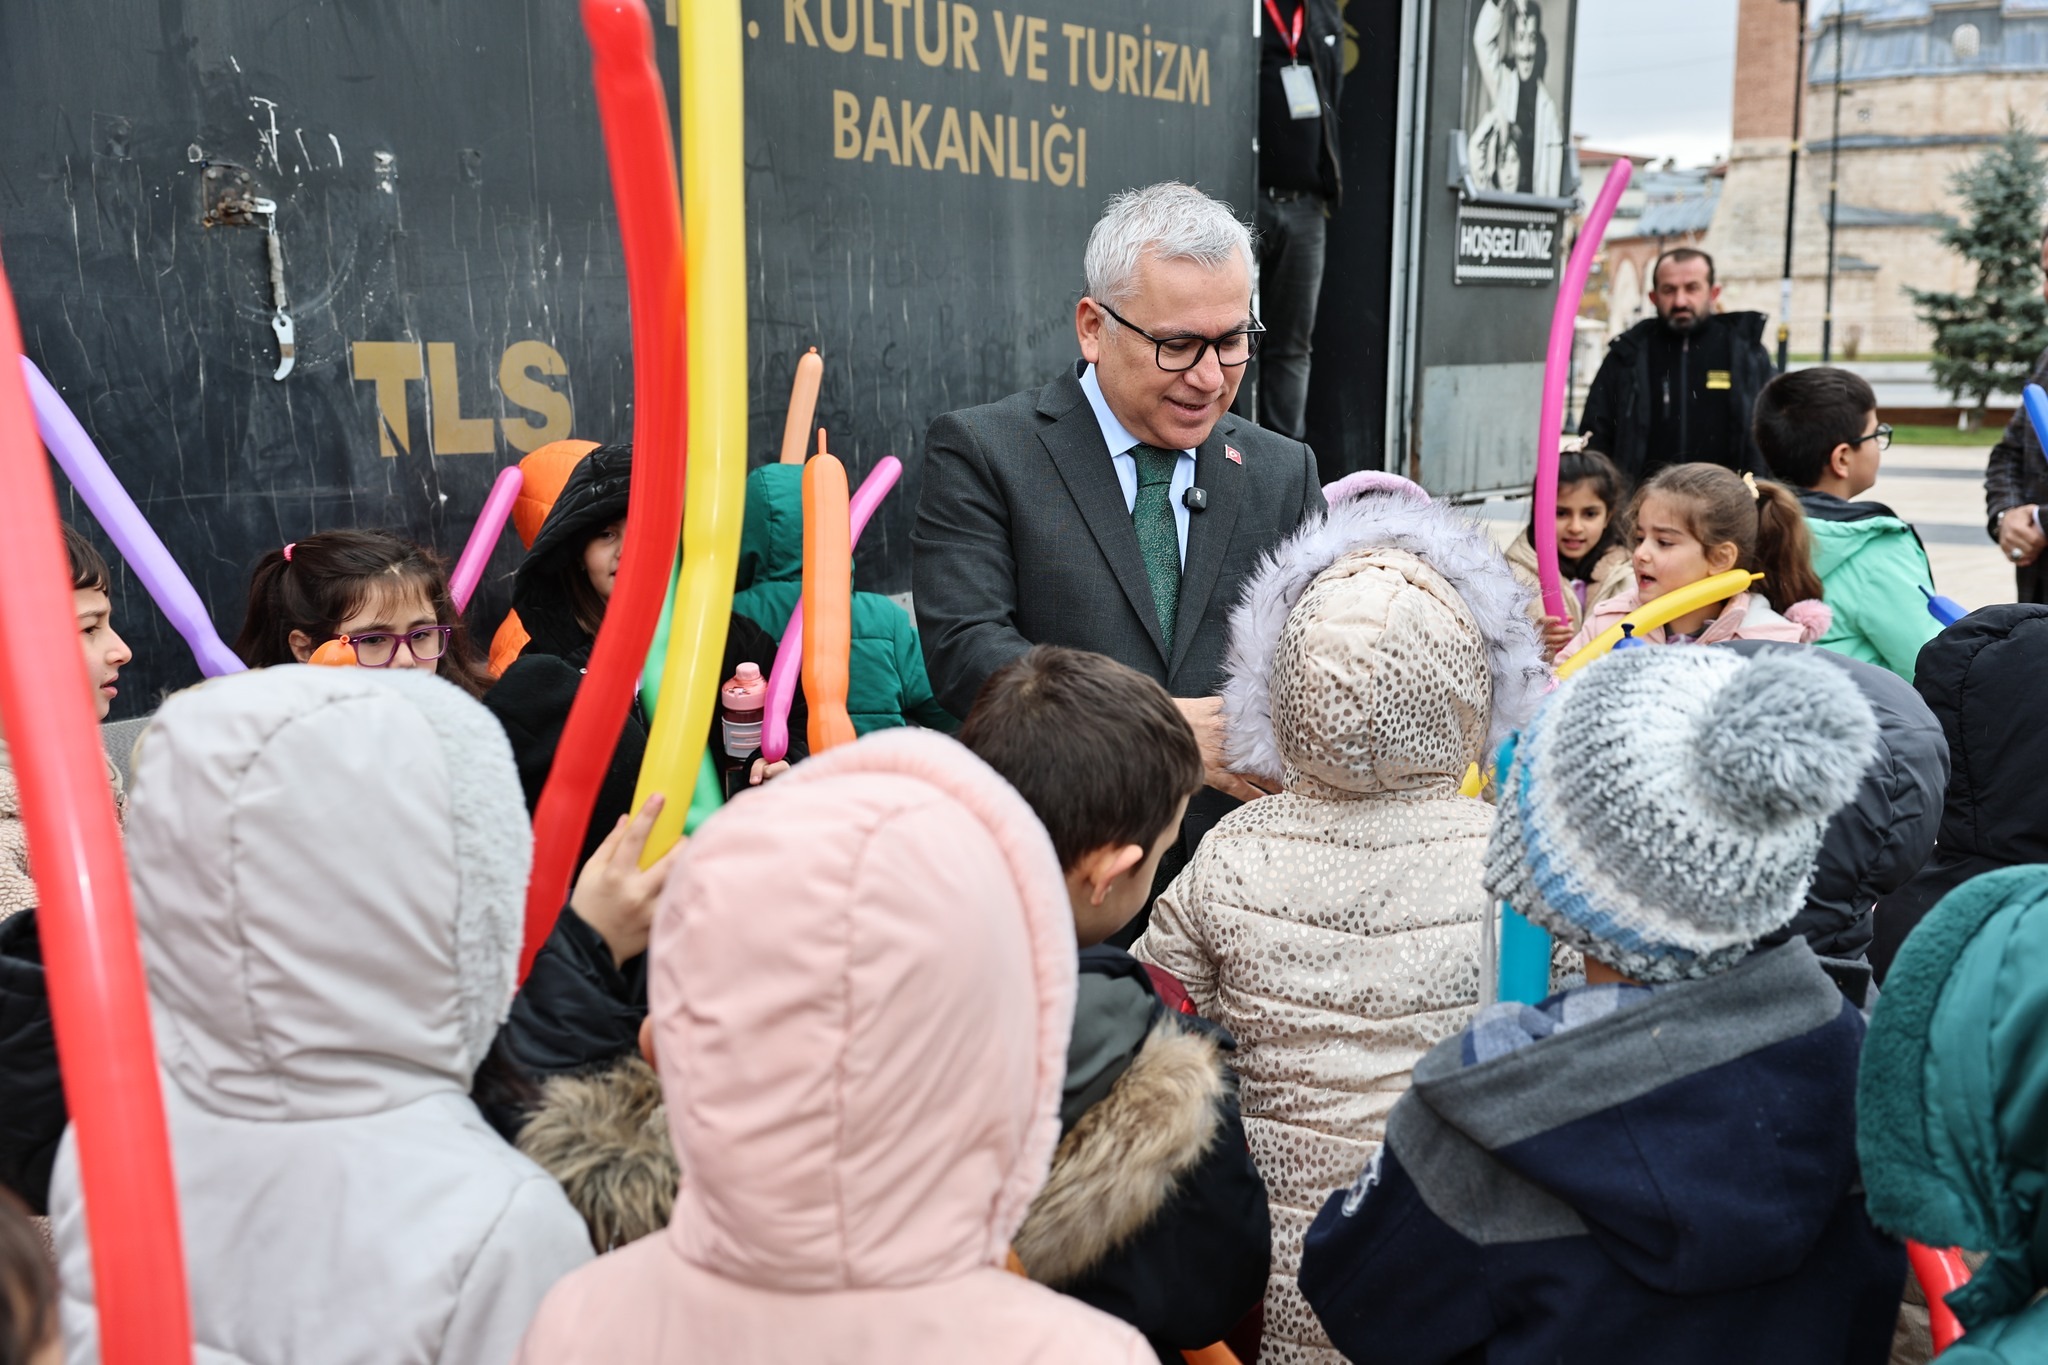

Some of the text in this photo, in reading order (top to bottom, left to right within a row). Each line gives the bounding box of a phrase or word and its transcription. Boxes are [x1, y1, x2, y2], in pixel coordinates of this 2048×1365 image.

[993, 10, 1048, 82] VE
[1062, 23, 1211, 107] TURİZM
[833, 89, 1087, 188] BAKANLIĞI
[1460, 222, 1553, 264] HOŞGELDİNİZ
[352, 340, 573, 458] TLS
